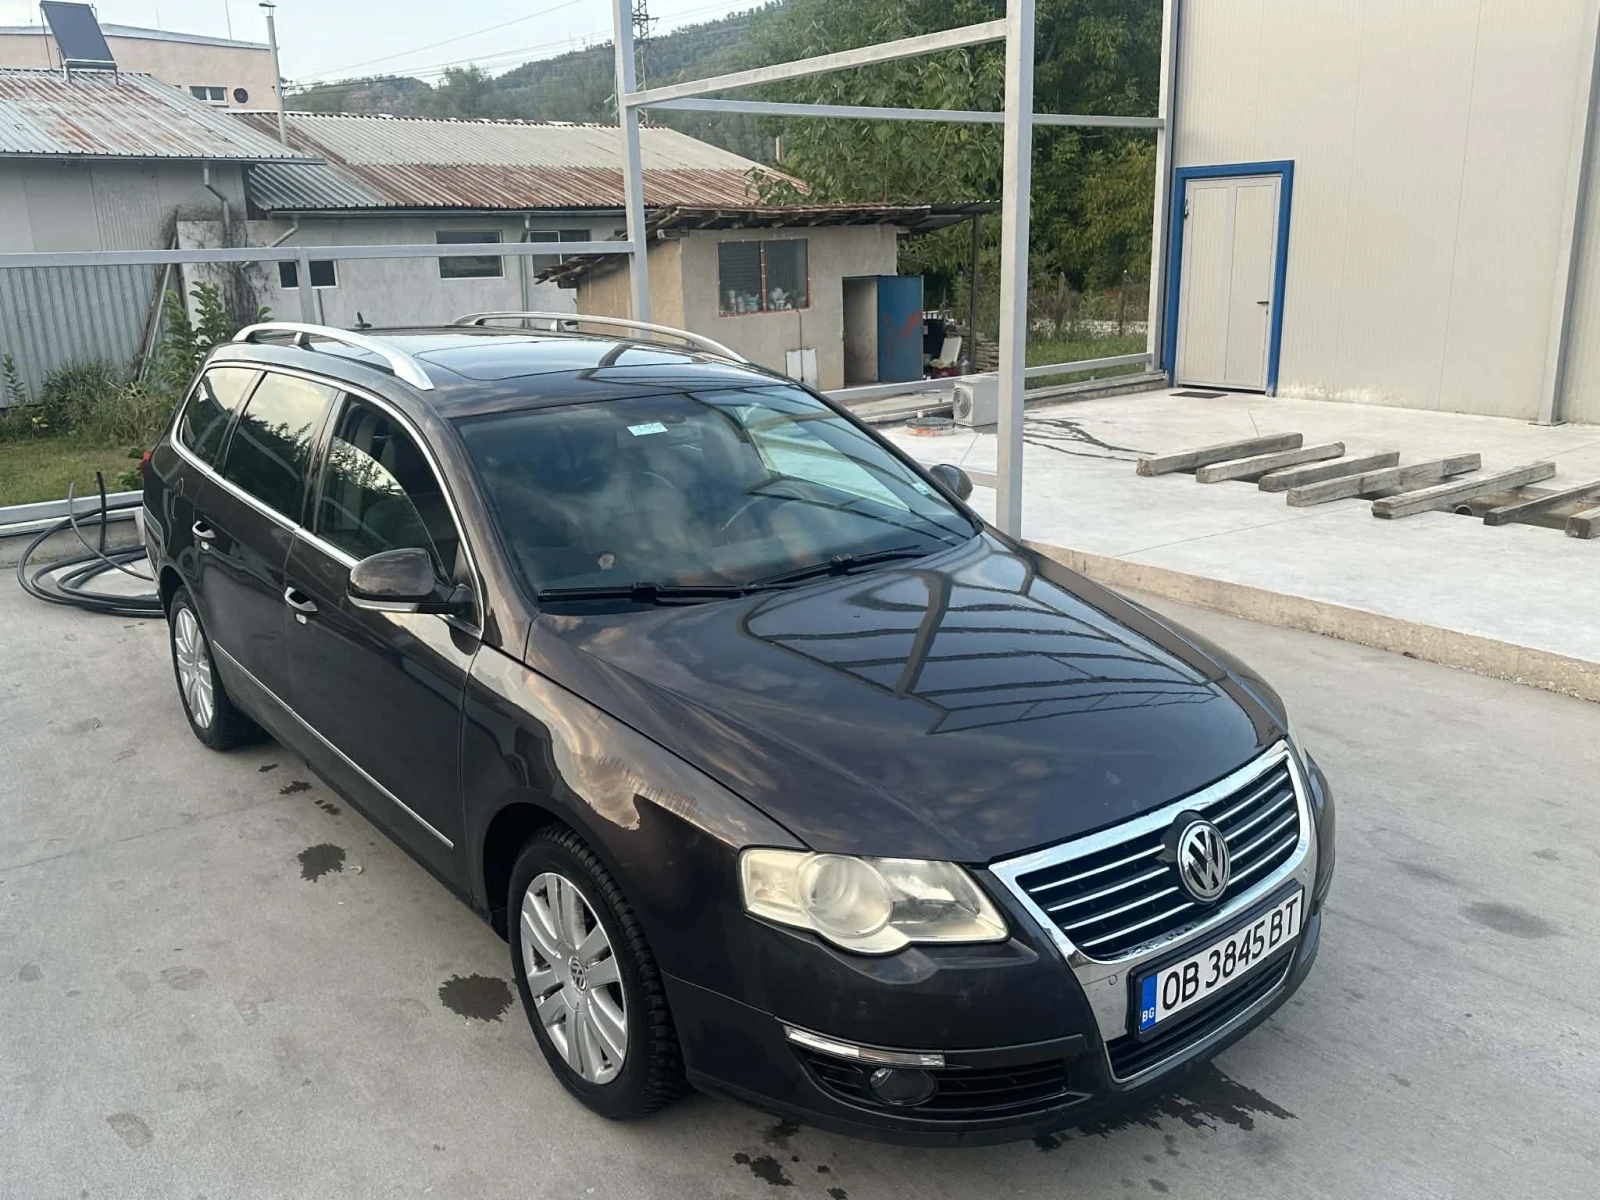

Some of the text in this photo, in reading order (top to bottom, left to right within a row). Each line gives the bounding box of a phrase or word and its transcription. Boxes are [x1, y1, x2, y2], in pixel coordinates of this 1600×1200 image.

[1162, 897, 1298, 1010] OB 3845 BT
[1142, 1007, 1155, 1023] BG
